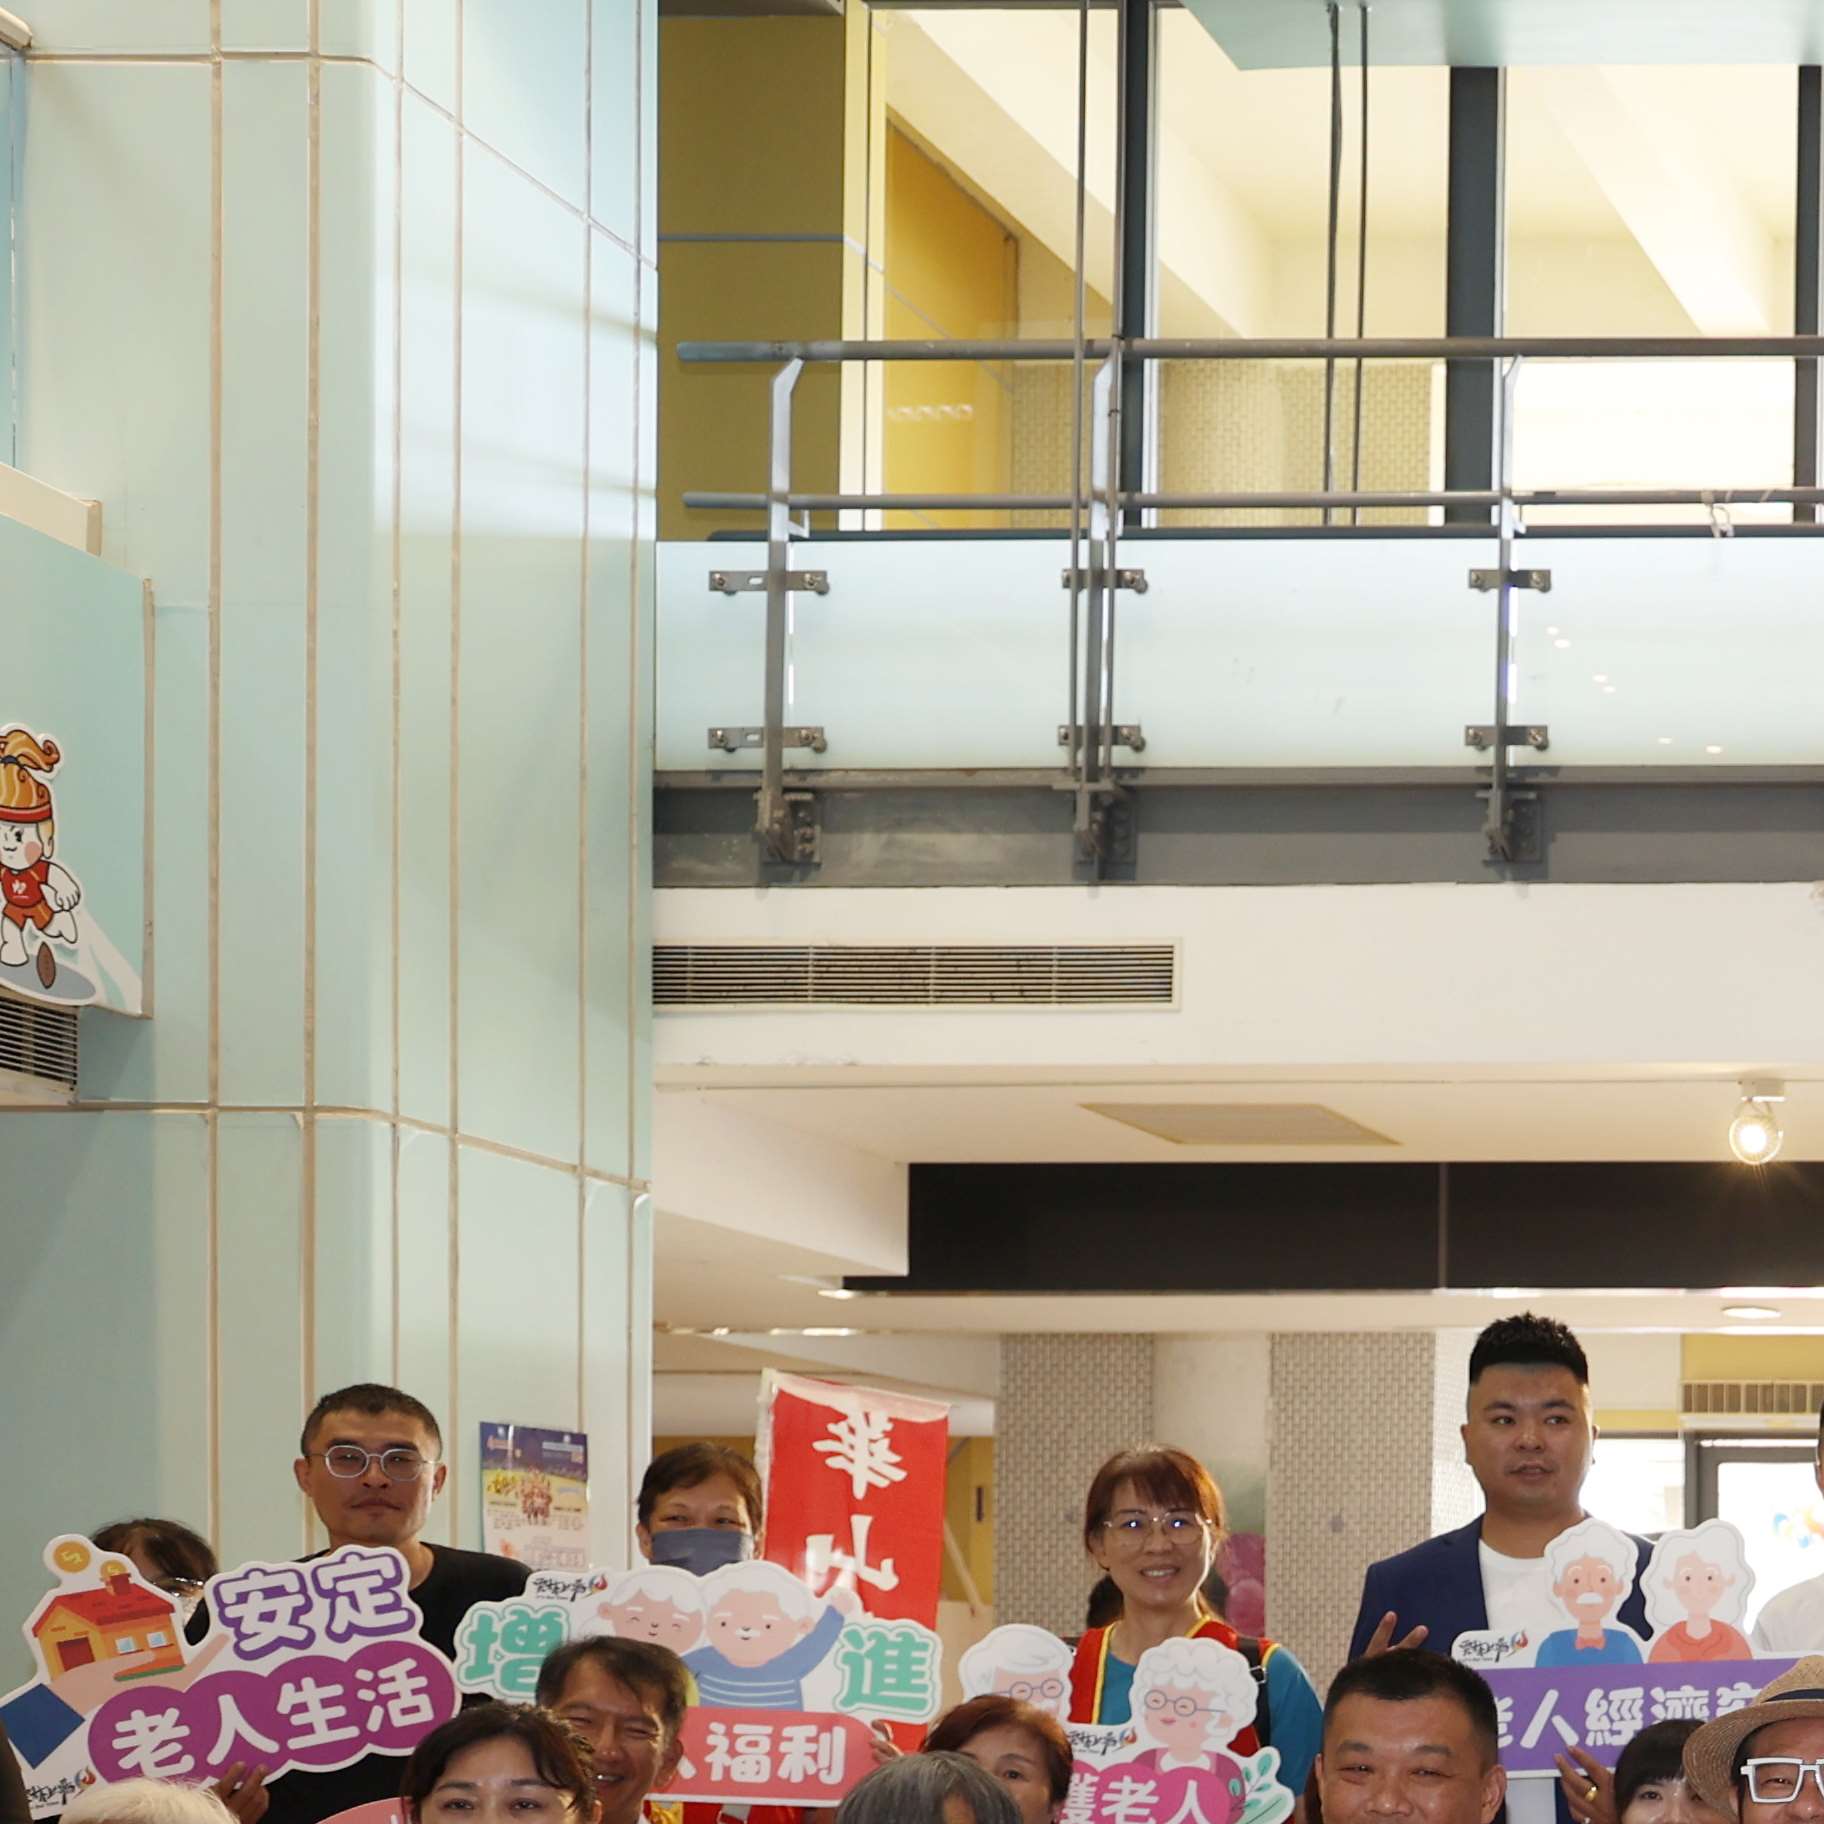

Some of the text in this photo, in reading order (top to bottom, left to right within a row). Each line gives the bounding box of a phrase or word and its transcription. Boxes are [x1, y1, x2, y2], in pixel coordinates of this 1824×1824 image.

[213, 1554, 418, 1662] 安定
[112, 1657, 436, 1785] 老人生活
[837, 1629, 937, 1719] 進
